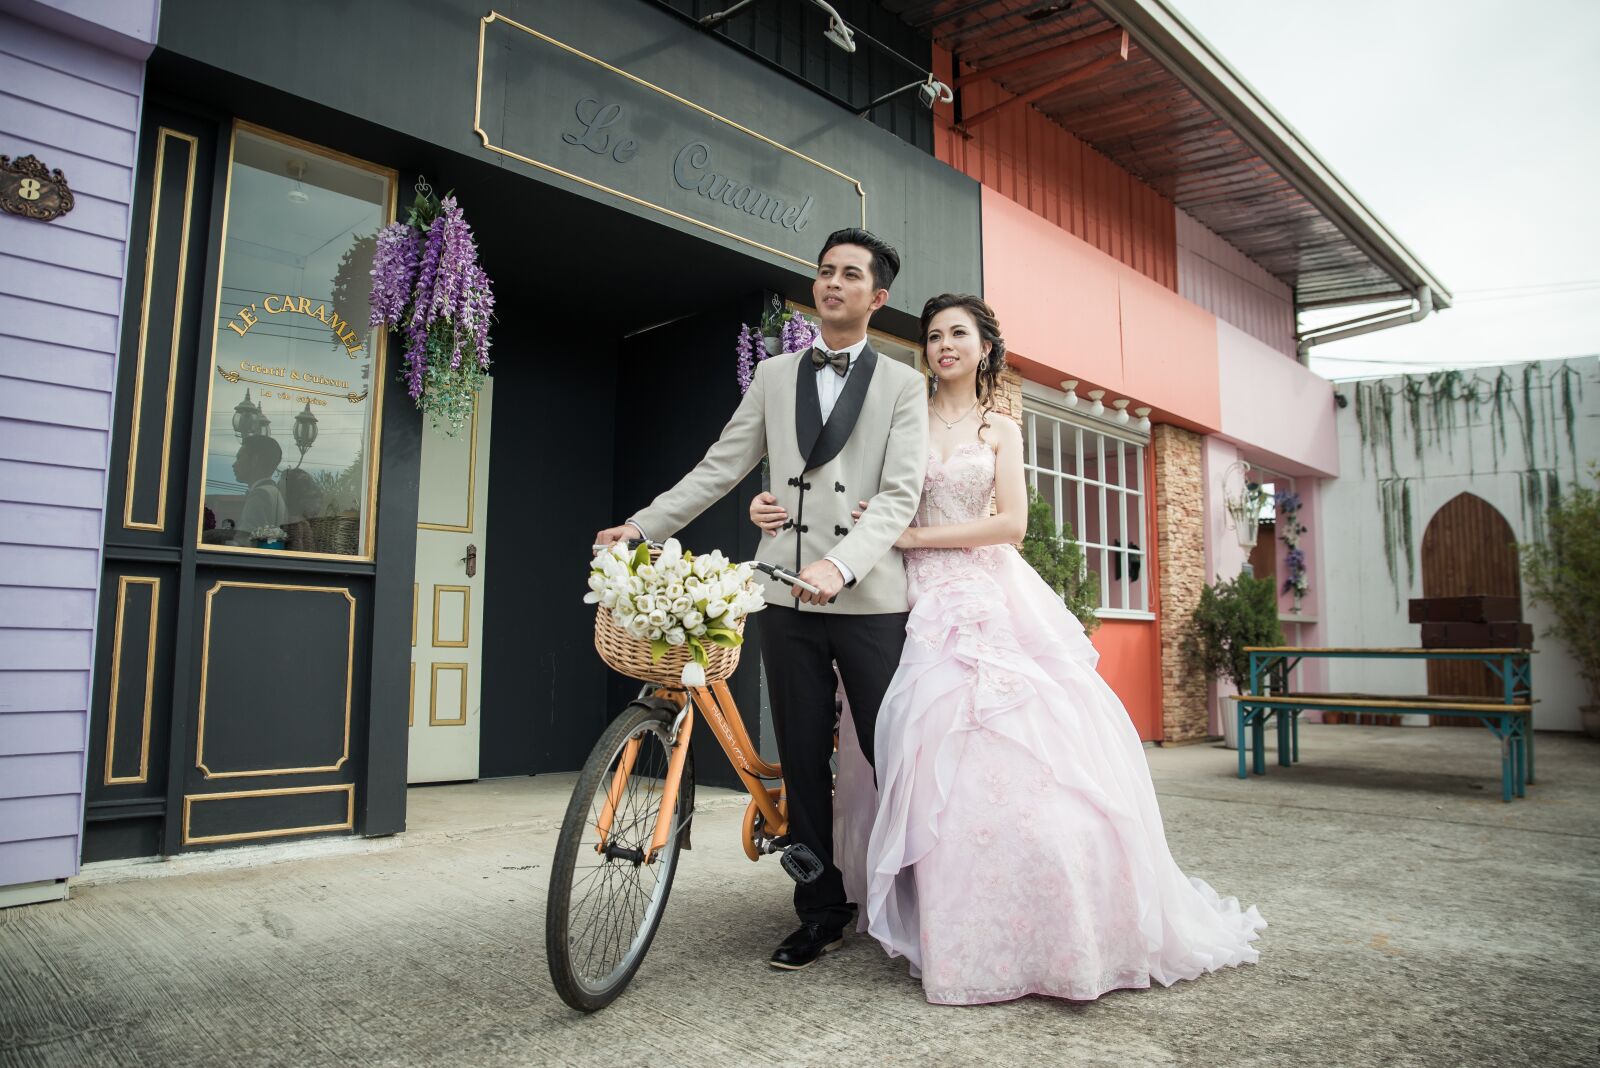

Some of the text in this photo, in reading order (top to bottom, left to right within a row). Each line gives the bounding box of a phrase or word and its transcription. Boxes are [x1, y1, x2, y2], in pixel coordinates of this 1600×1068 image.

[561, 99, 813, 233] Le Caramel
[18, 178, 41, 201] 8
[263, 295, 364, 359] CARAMEL
[290, 369, 300, 380] &
